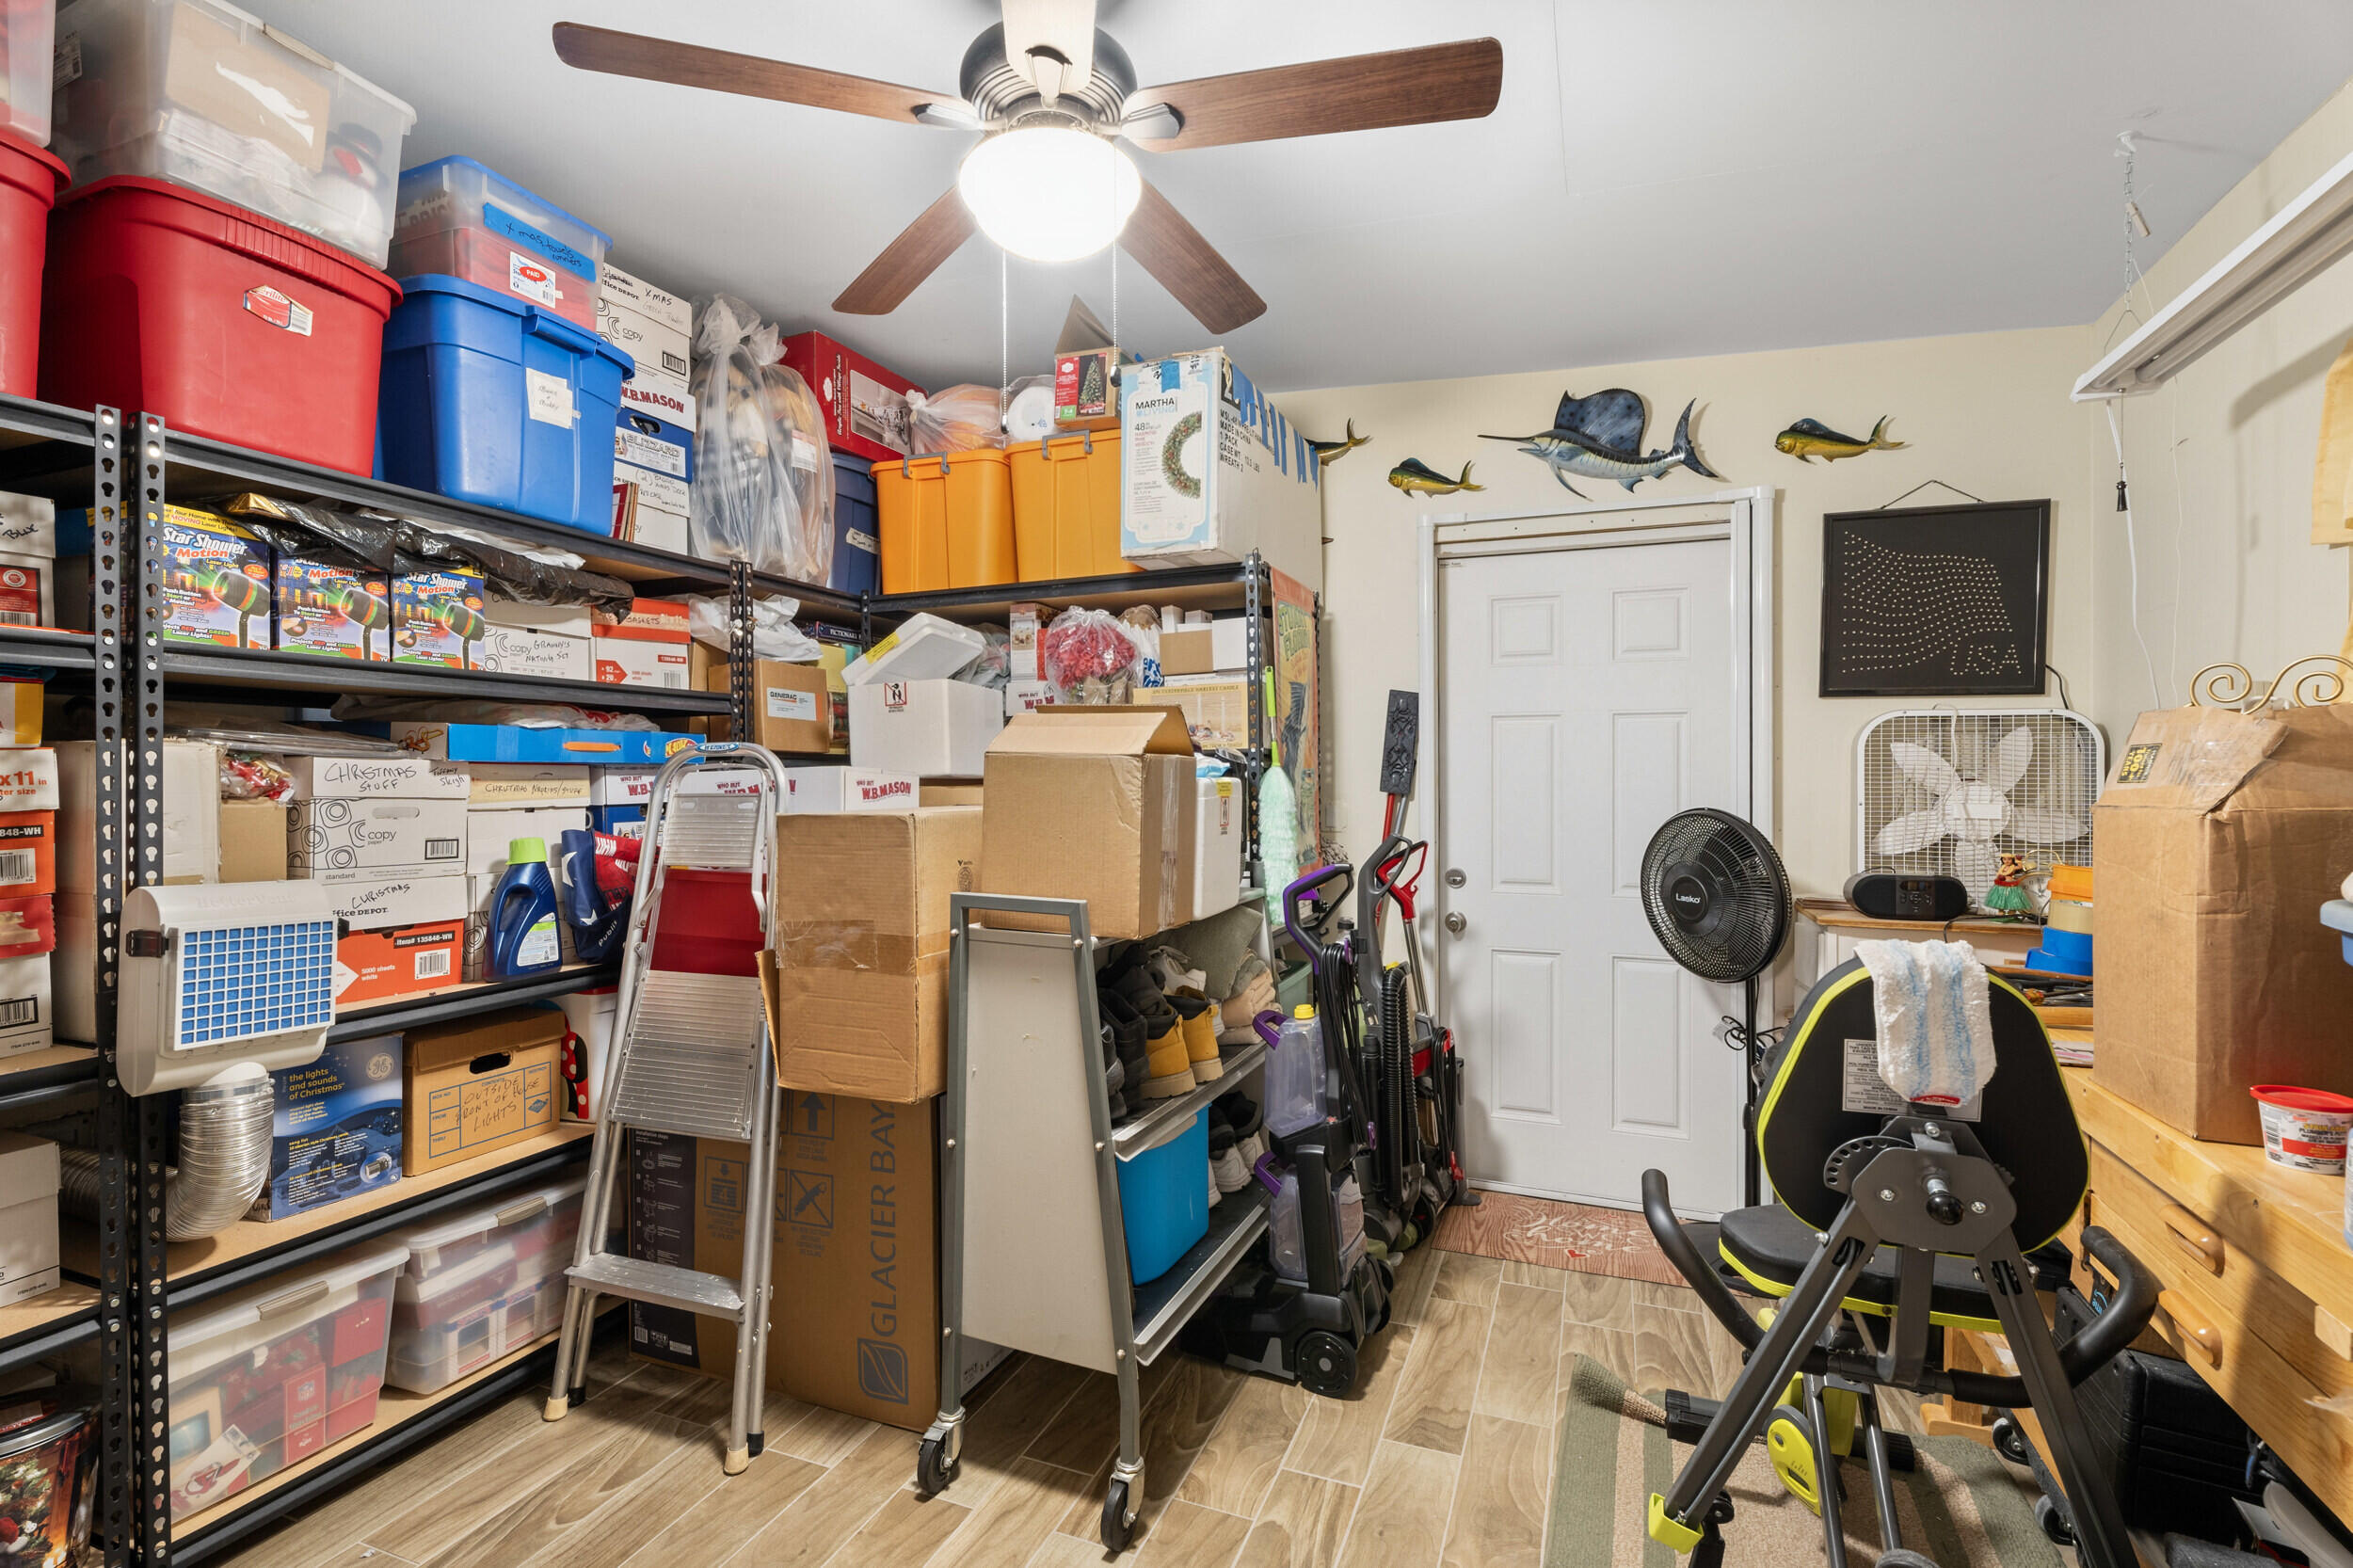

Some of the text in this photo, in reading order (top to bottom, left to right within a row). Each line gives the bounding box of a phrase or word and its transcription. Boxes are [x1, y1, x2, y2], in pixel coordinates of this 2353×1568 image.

[526, 269, 540, 279] PAID
[617, 288, 639, 300] DEPOT
[623, 328, 643, 342] copy
[1135, 397, 1175, 409] MARTHA
[1144, 406, 1176, 416] LIVING
[1134, 422, 1145, 431] 48
[1220, 420, 1234, 433] MADE
[1240, 431, 1251, 445] CHINA
[1225, 432, 1238, 447] PACK
[1220, 442, 1233, 455] CASE
[1220, 453, 1240, 469] WREATH
[171, 515, 200, 525] MOVING
[188, 512, 206, 520] Home
[163, 527, 248, 555] Star Shower
[176, 548, 229, 558] Motion
[309, 568, 353, 579] Motion
[429, 573, 467, 589] Shower
[418, 585, 454, 595] Motion
[172, 629, 192, 637] Laser
[509, 644, 532, 655] copy
[1949, 644, 2022, 675] USA
[770, 691, 797, 700] GENERAC
[861, 782, 912, 800] W.B.MASON
[368, 830, 396, 841] copy
[1676, 893, 1700, 904] Lasko
[358, 907, 388, 916] DEPOT
[289, 1068, 328, 1082] the lights
[289, 1075, 337, 1091] and sounds
[289, 1083, 343, 1100] of Christmas
[464, 1076, 520, 1104] OUTSIDE
[473, 1101, 517, 1132] LIGHTS
[870, 1185, 896, 1337] GLACIER
